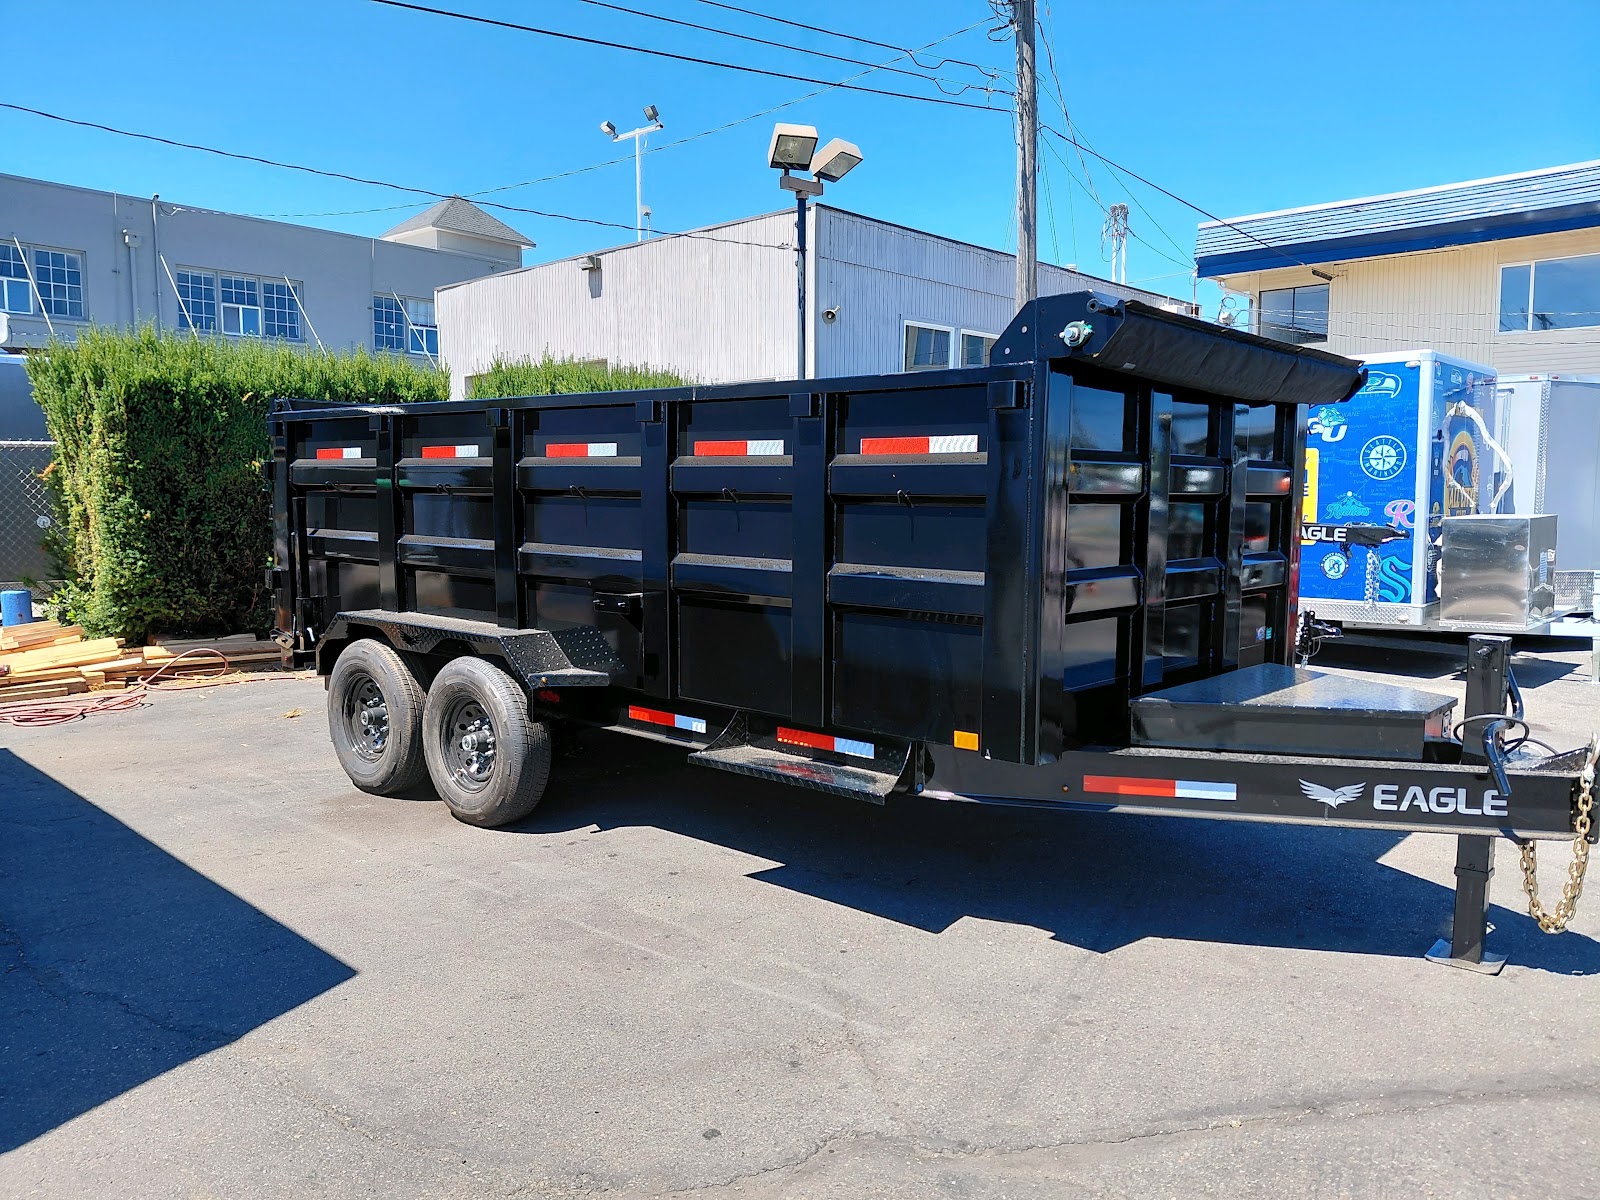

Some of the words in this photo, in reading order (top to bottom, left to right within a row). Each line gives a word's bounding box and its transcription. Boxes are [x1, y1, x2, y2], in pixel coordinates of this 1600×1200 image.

[1364, 438, 1402, 453] SEATTLE
[1364, 460, 1402, 477] MARINERS
[1302, 526, 1347, 542] AGLE
[1373, 784, 1509, 817] EAGLE
